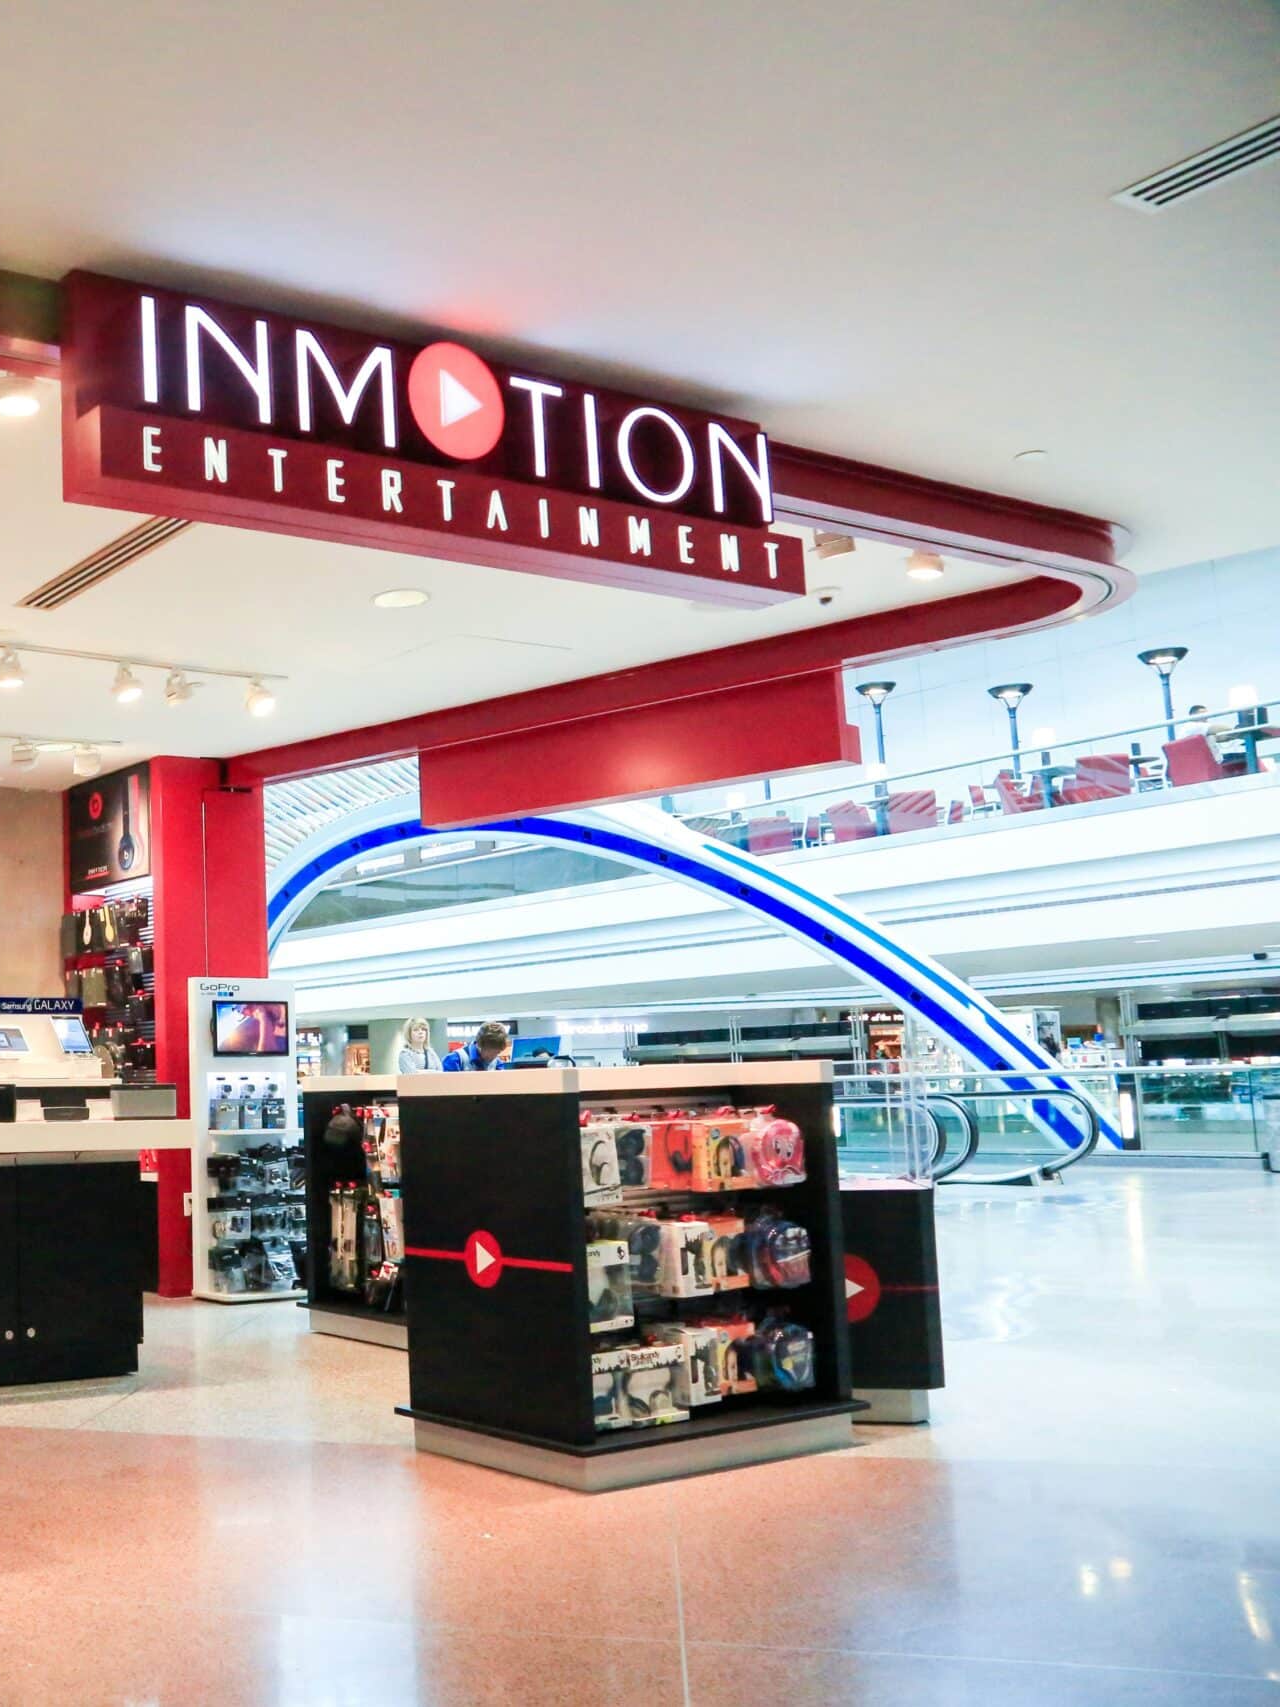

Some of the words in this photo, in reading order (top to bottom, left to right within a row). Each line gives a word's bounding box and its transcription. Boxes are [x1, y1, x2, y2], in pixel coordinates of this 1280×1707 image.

[142, 426, 780, 580] ENTERTAINMENT
[200, 983, 240, 991] GoPro
[1, 1002, 33, 1012] Samsung
[34, 1000, 75, 1010] GALAXY
